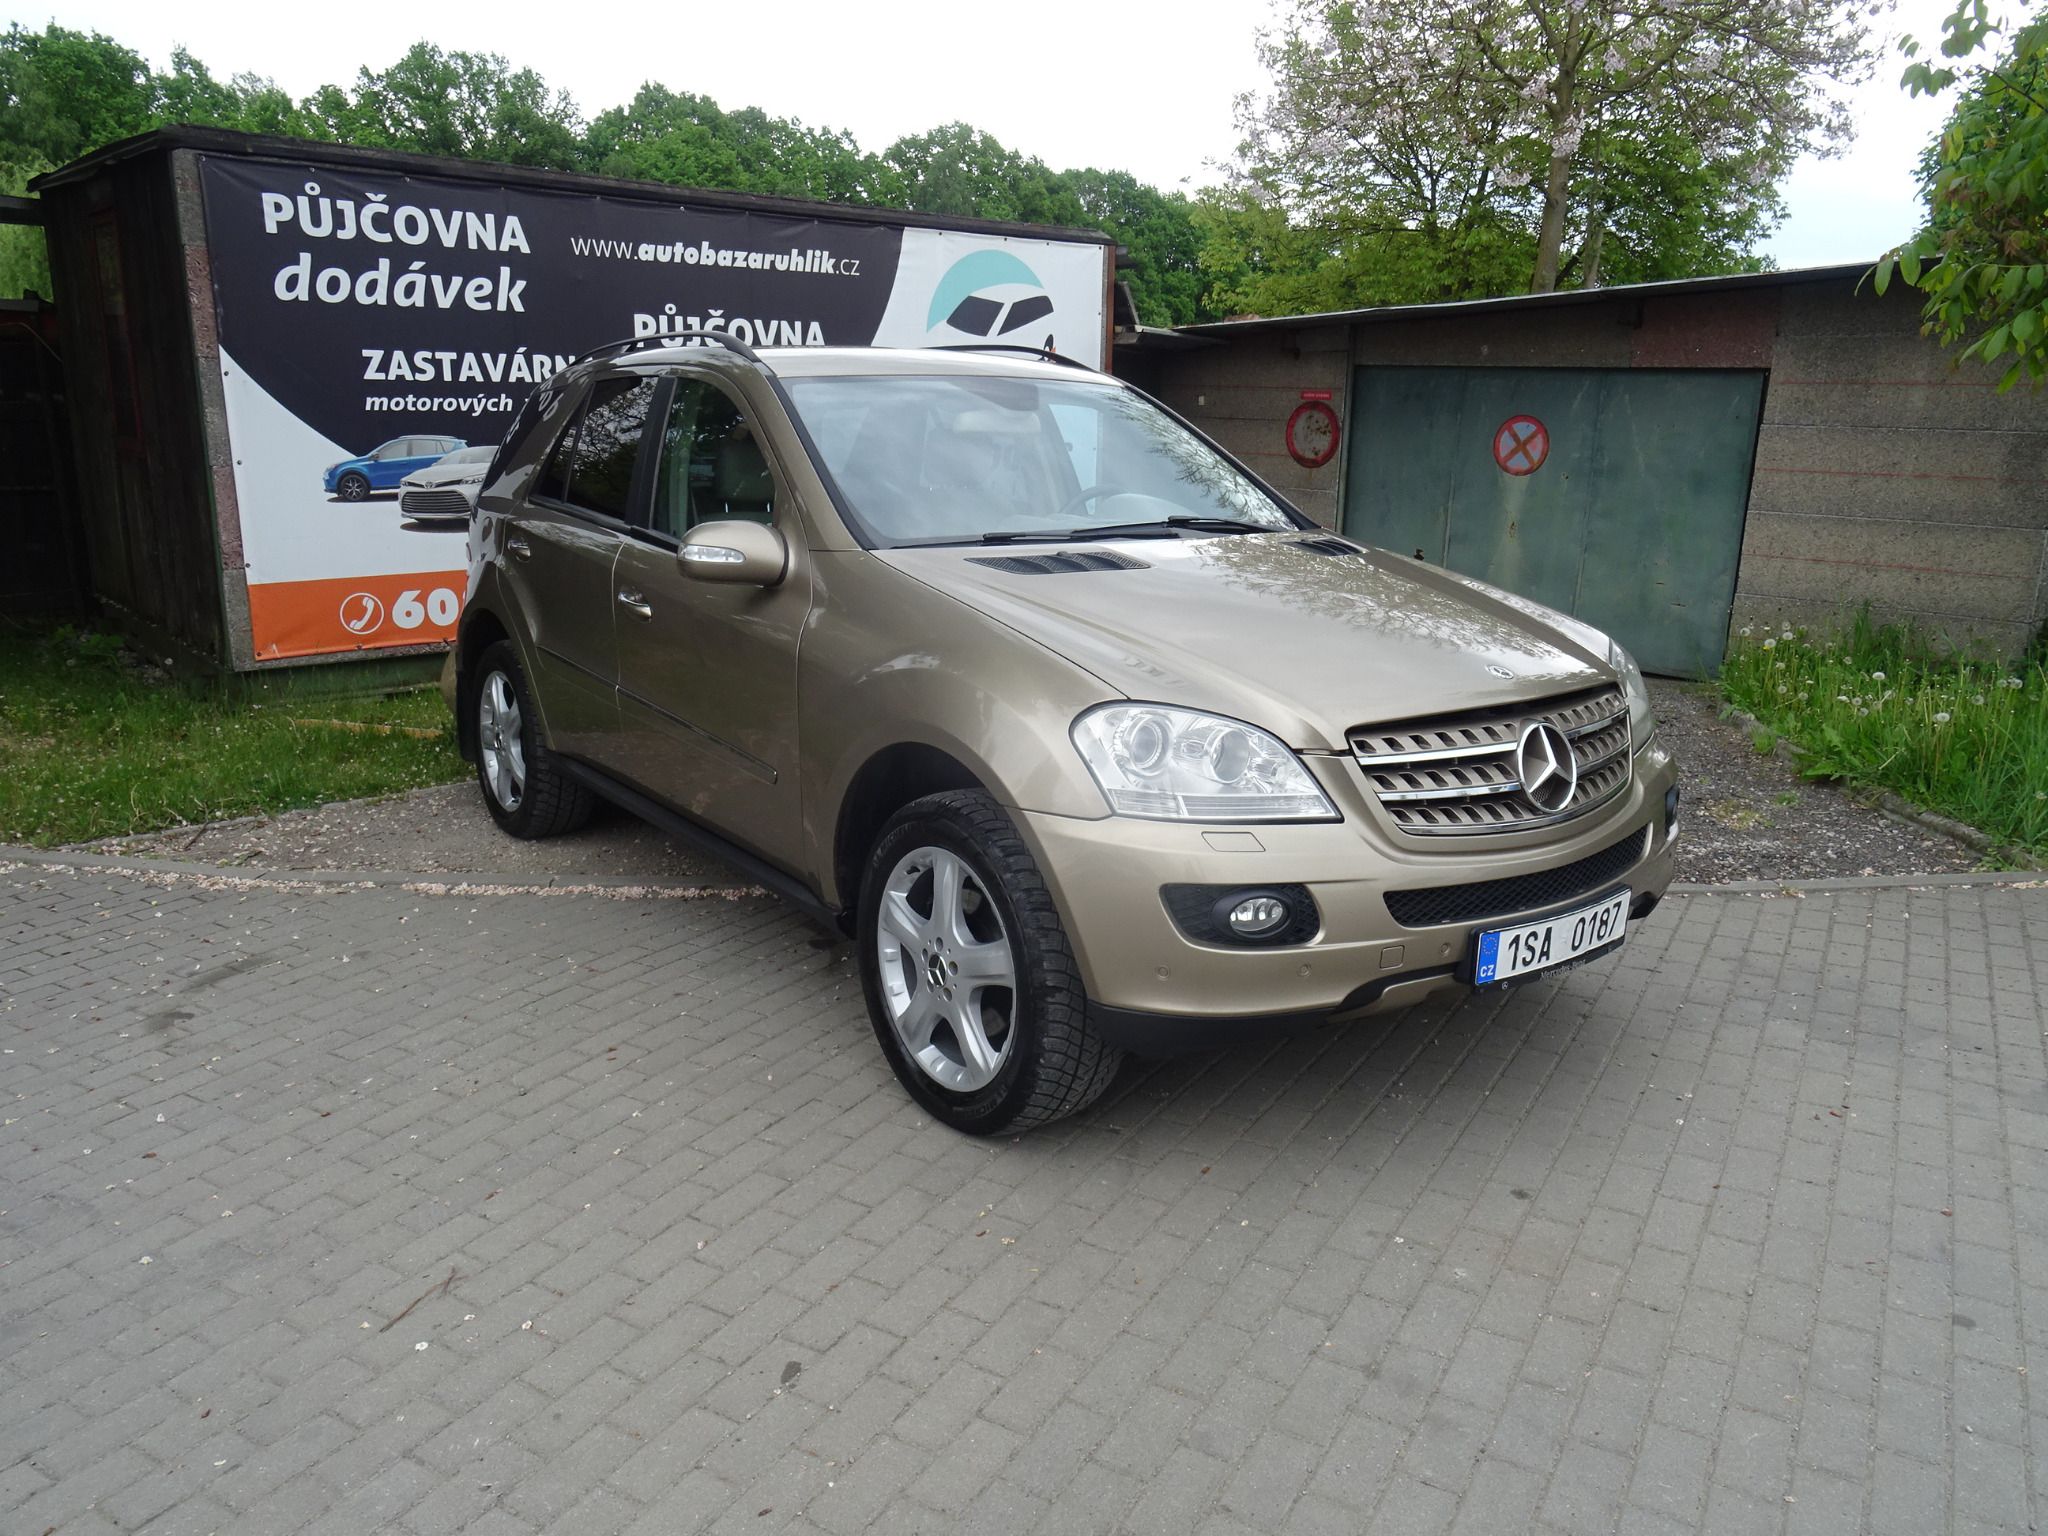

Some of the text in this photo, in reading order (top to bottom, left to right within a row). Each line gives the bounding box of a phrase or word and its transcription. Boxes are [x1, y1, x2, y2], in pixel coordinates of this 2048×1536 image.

[262, 181, 531, 254] PŮJČOVNA
[570, 237, 861, 277] www.autobazaruhlik.cz
[274, 251, 527, 313] dodávek
[633, 303, 826, 348] PŮJČOVNA
[361, 346, 577, 384] ZASTAVÁRN
[365, 393, 513, 417] motorových
[391, 587, 467, 630] 60
[1508, 900, 1622, 971] 1SA 0187
[1480, 965, 1495, 978] CZ
